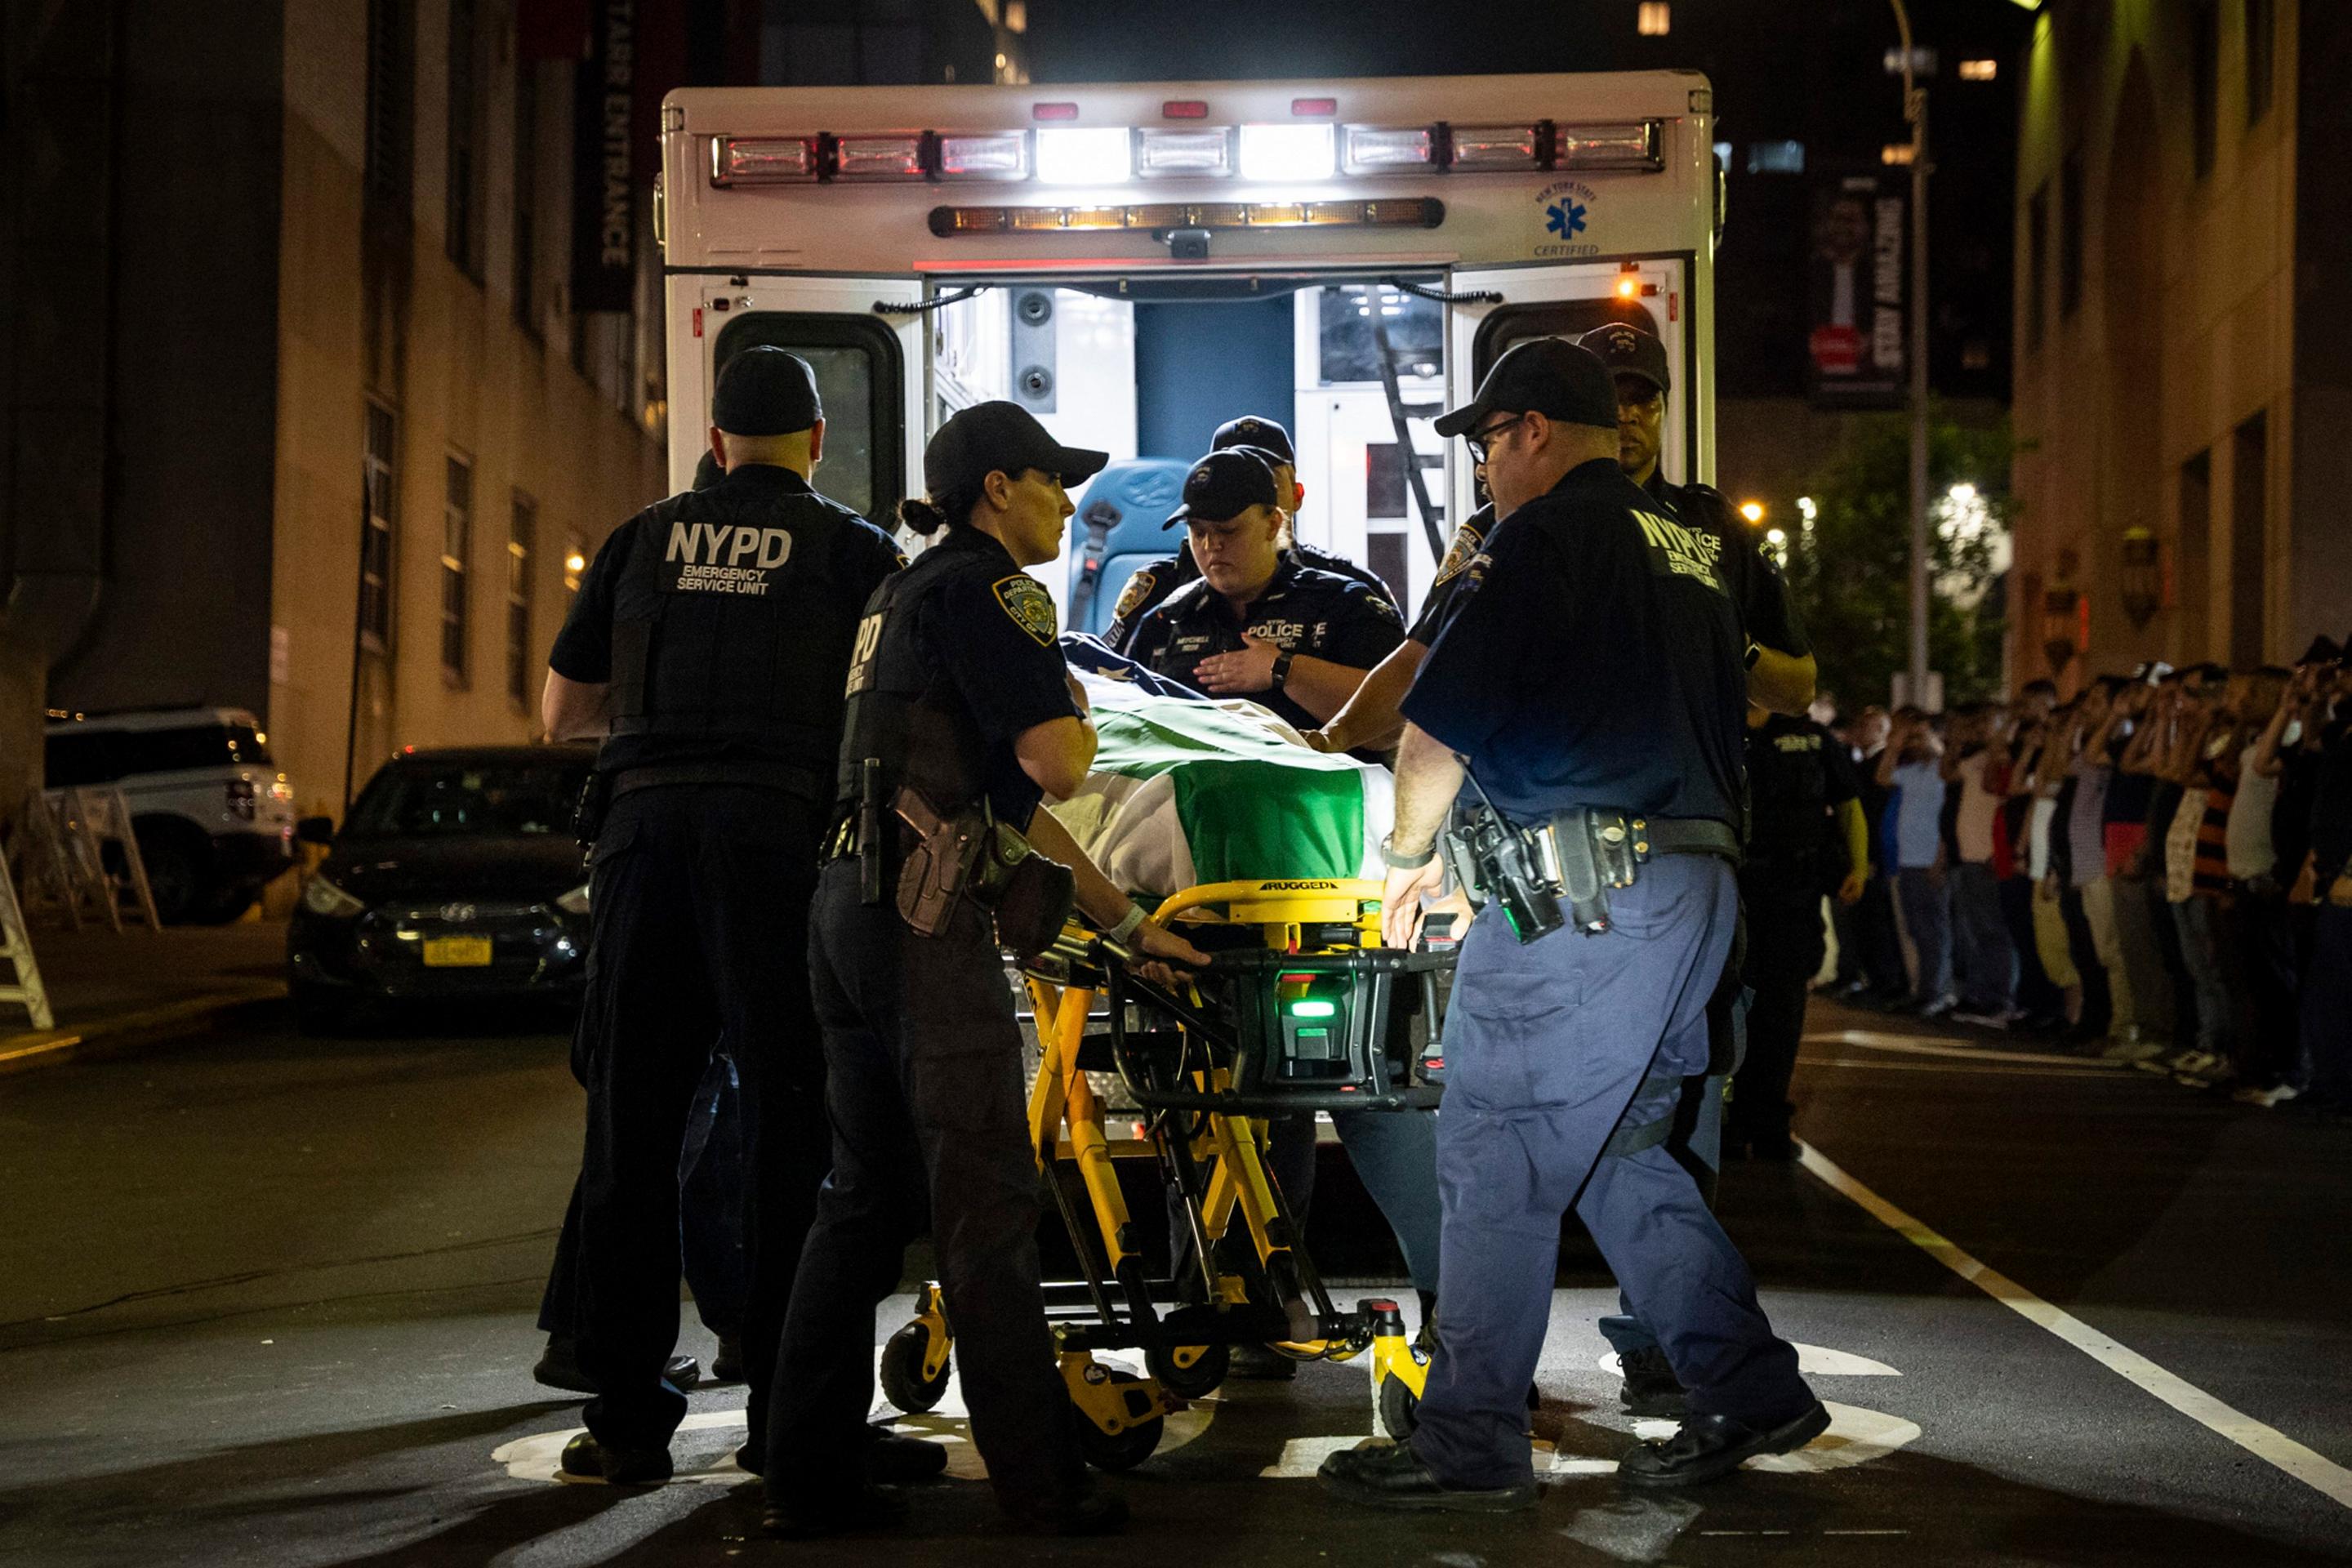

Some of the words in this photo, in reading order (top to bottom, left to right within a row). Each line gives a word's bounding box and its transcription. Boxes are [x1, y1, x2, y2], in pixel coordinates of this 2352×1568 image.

[602, 92, 632, 266] ENTRANCE
[1534, 244, 1600, 256] CERTIFIED
[666, 522, 793, 569] NYPD
[1628, 509, 1713, 567] NYPD
[683, 565, 767, 582] EMERGENCY
[677, 577, 735, 593] SERVICE
[737, 582, 769, 595] UNIT
[1010, 606, 1027, 622] CITY
[1026, 622, 1038, 633] OF
[1247, 624, 1304, 638] POLICE
[1268, 881, 1330, 891] RUGGED
